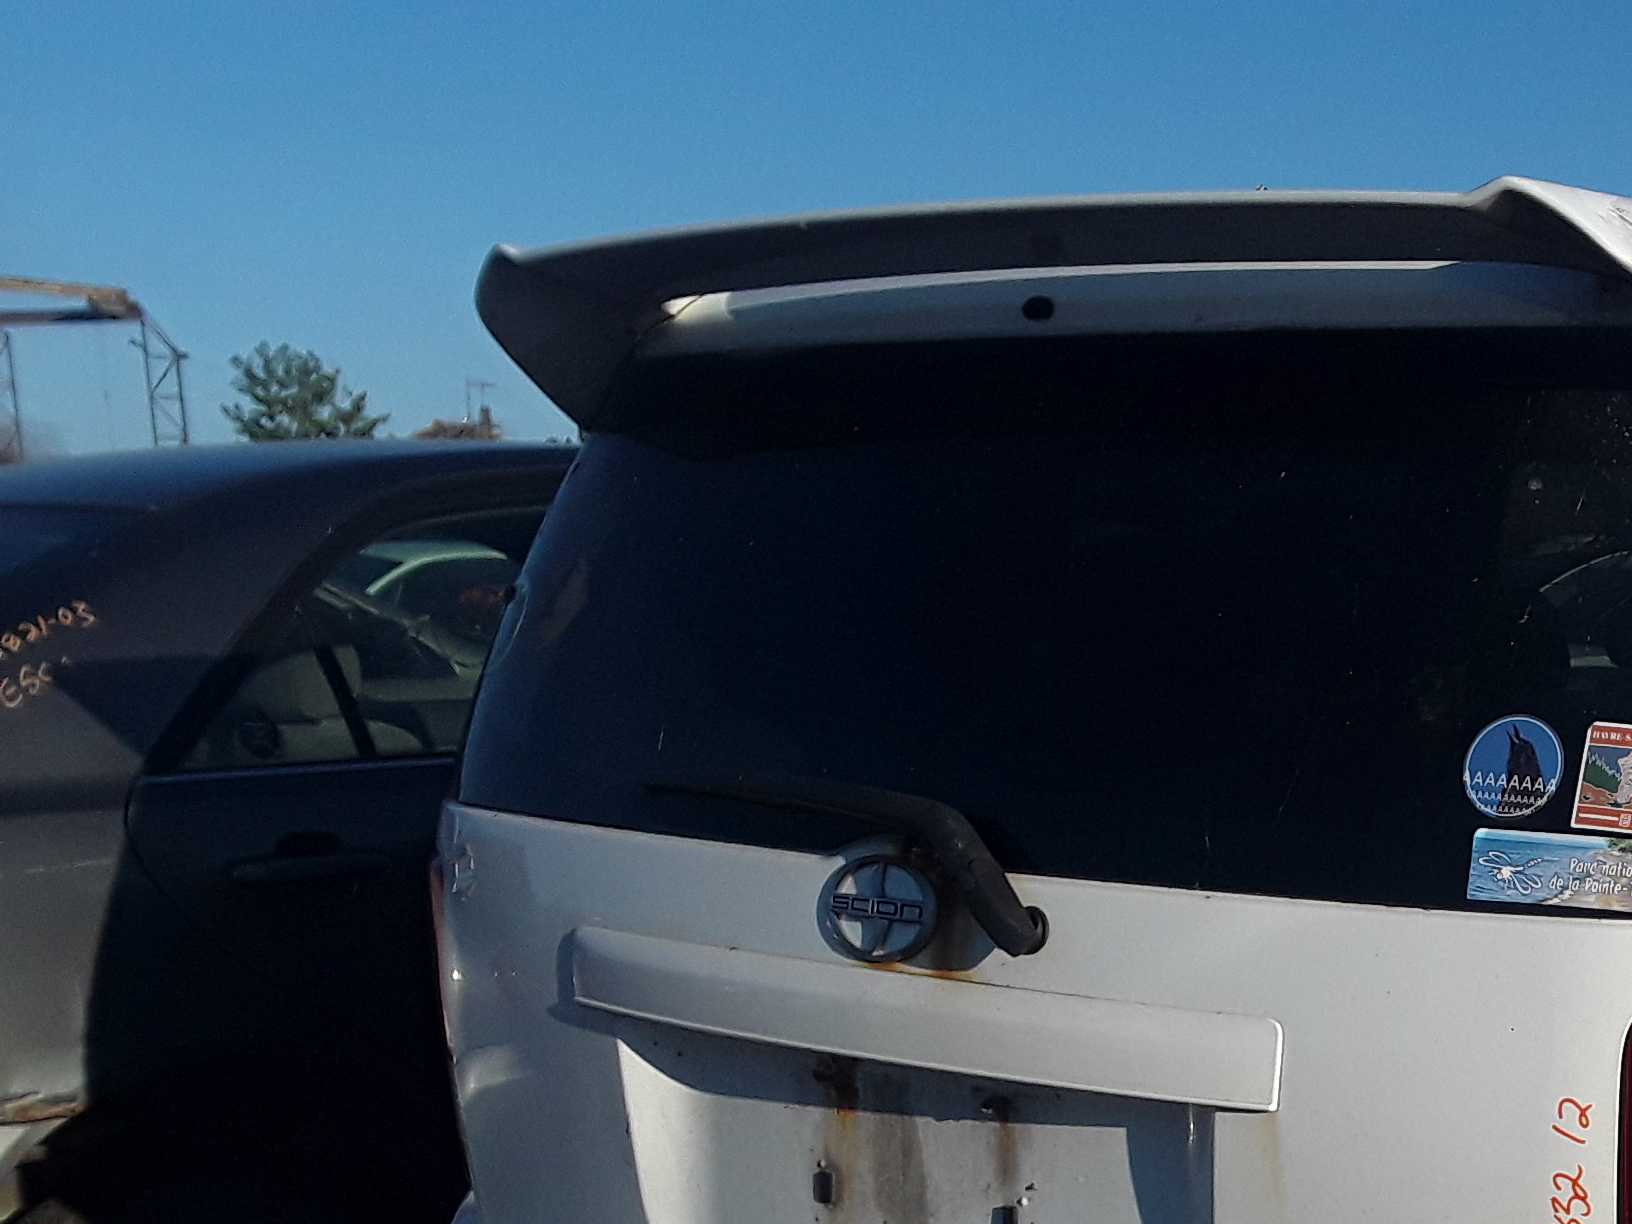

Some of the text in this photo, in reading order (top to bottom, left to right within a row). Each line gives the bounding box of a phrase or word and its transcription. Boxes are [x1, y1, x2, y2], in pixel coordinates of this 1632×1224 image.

[1569, 858, 1599, 875] Parc
[1549, 875, 1564, 890] de
[1568, 875, 1580, 891] la
[831, 893, 924, 919] SCION
[1552, 1097, 1594, 1145] 12
